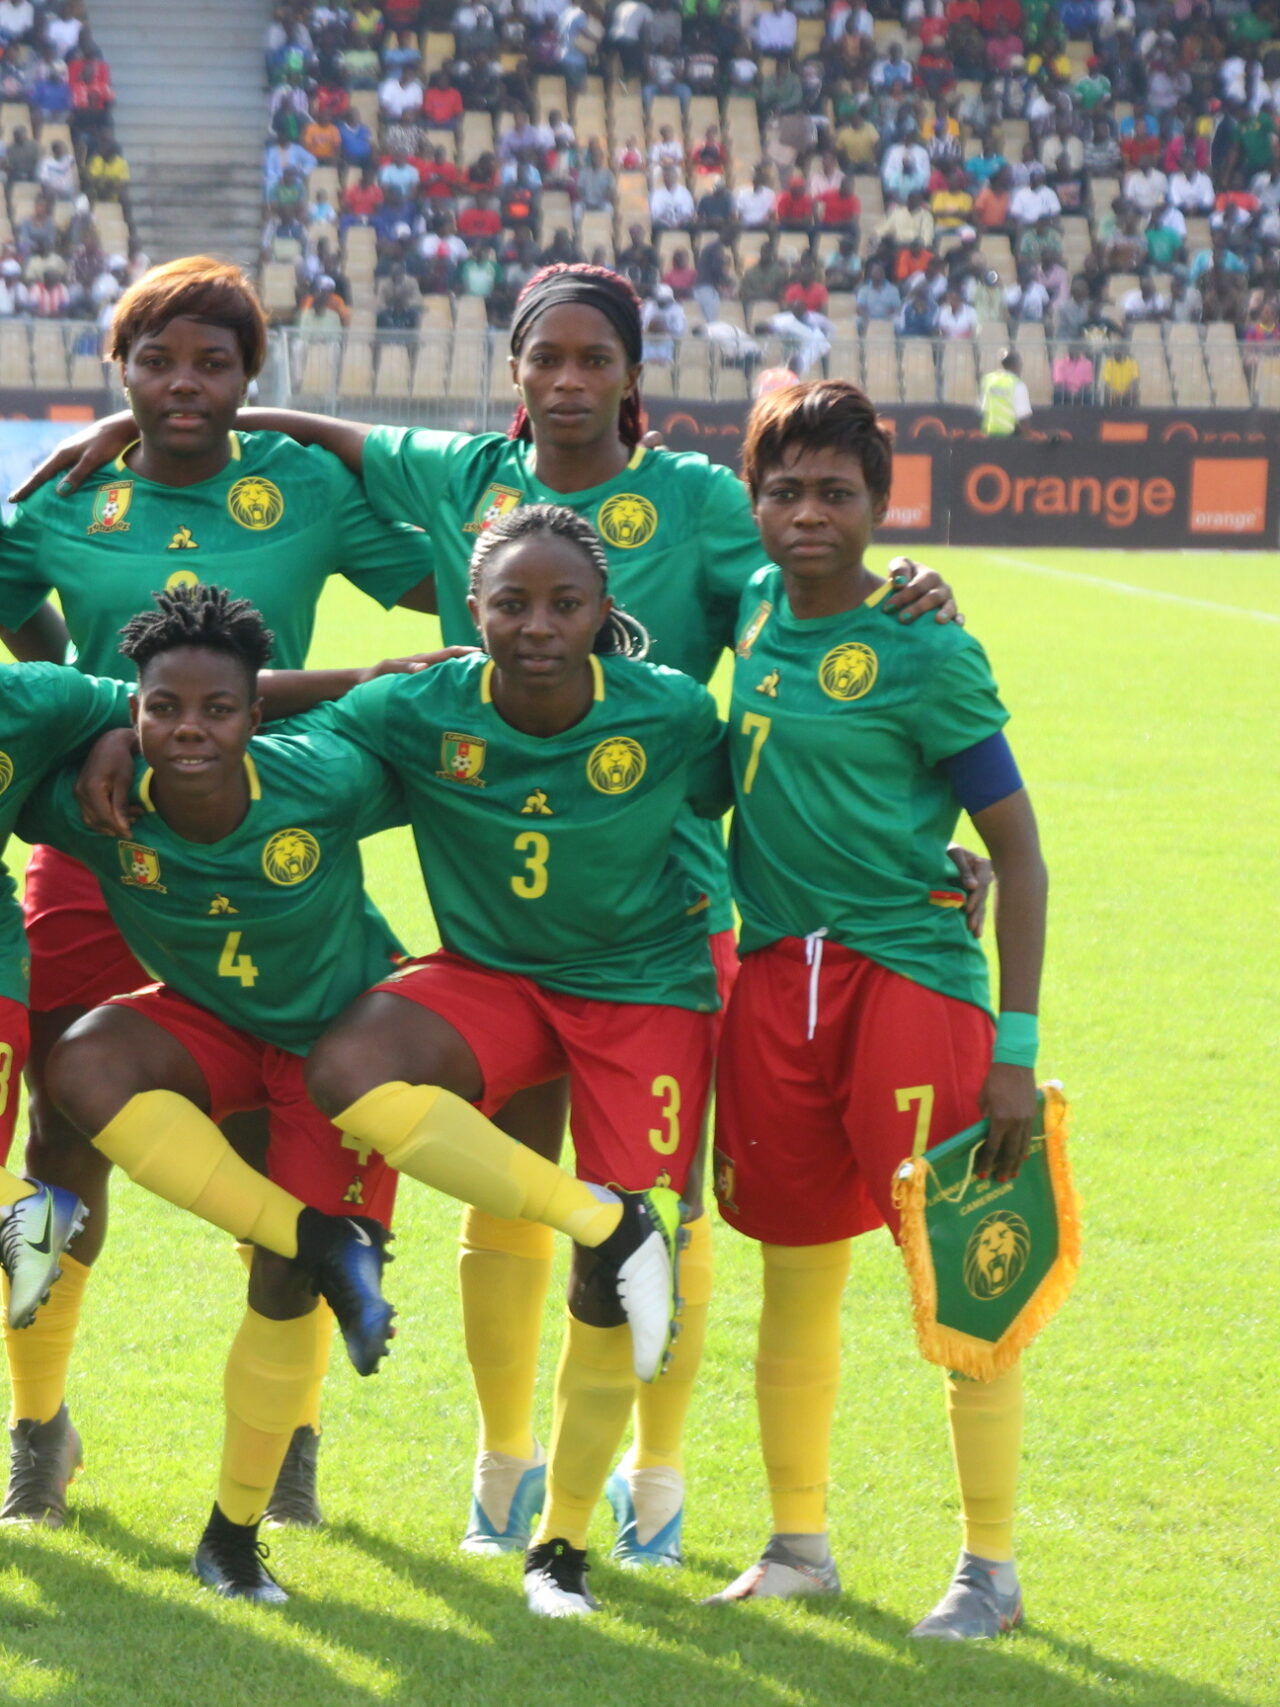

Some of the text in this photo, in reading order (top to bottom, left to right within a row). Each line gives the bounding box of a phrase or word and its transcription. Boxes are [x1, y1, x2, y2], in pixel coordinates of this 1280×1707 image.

[964, 463, 1177, 529] Orange
[1195, 511, 1257, 533] orange
[741, 711, 771, 795] 7
[511, 831, 550, 899] 3
[218, 931, 259, 987] 4
[648, 1074, 681, 1156] 3
[894, 1084, 934, 1157] 7
